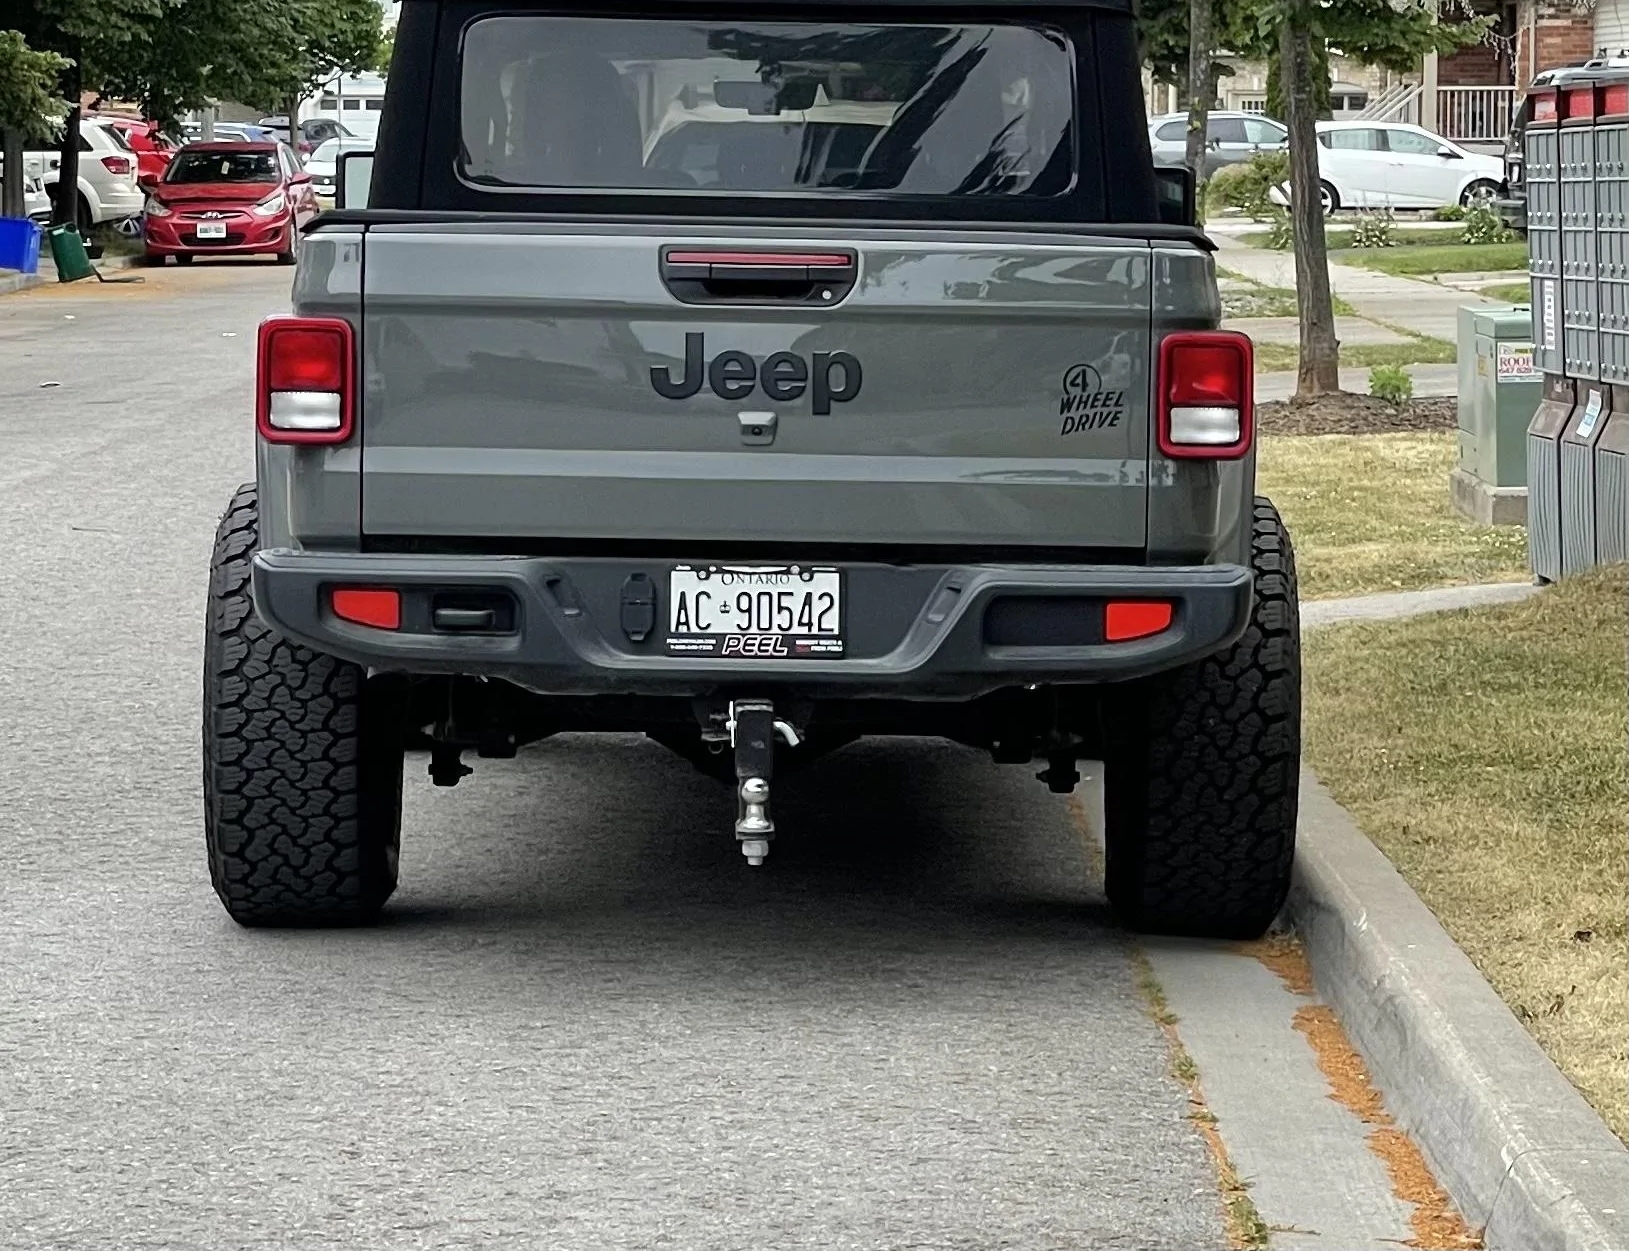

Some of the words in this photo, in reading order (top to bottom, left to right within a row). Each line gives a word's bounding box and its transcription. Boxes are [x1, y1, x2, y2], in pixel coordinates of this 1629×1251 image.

[650, 332, 862, 416] Jeep
[1069, 368, 1089, 393] 4
[1060, 391, 1124, 416] WHEEL
[1061, 411, 1123, 436] DRIVE
[721, 572, 790, 586] ONTARIO
[675, 591, 712, 632] AC
[736, 591, 835, 633] 90542
[722, 635, 788, 656] PEEL
